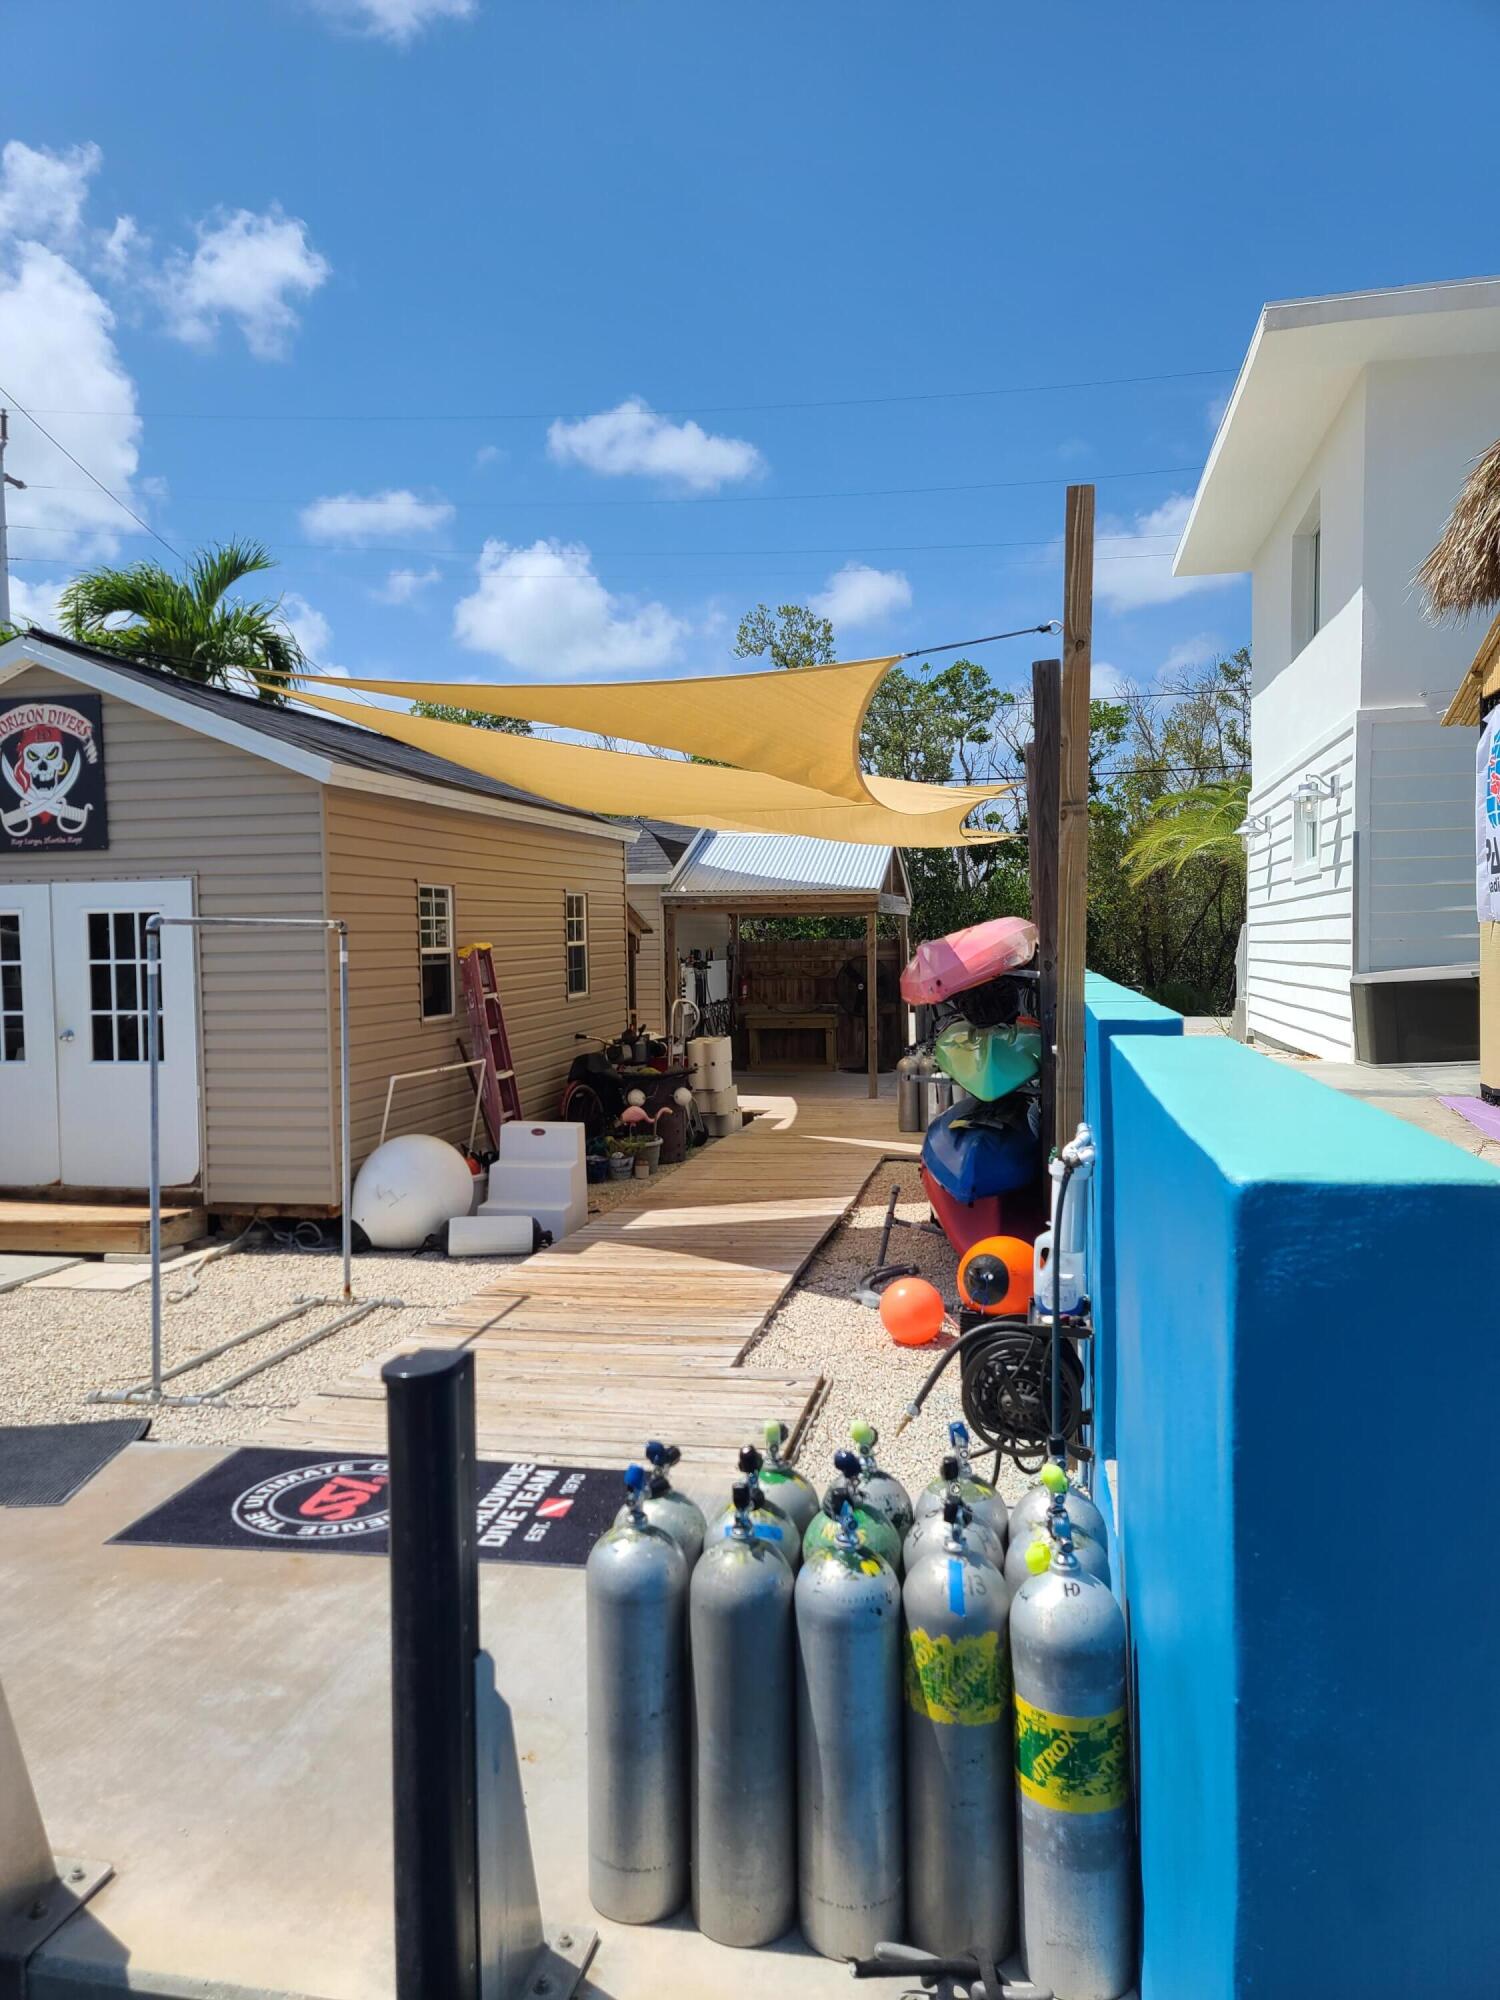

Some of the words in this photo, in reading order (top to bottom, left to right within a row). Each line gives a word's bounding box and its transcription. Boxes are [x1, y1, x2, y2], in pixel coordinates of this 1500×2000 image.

[0, 708, 45, 737] ORIZON
[47, 709, 91, 737] DIVERS
[243, 1463, 353, 1509] ULTIMATE
[244, 1511, 286, 1533] THE
[477, 1510, 528, 1547] DIVE
[507, 1470, 560, 1509] TEAM
[1063, 1582, 1081, 1598] HD
